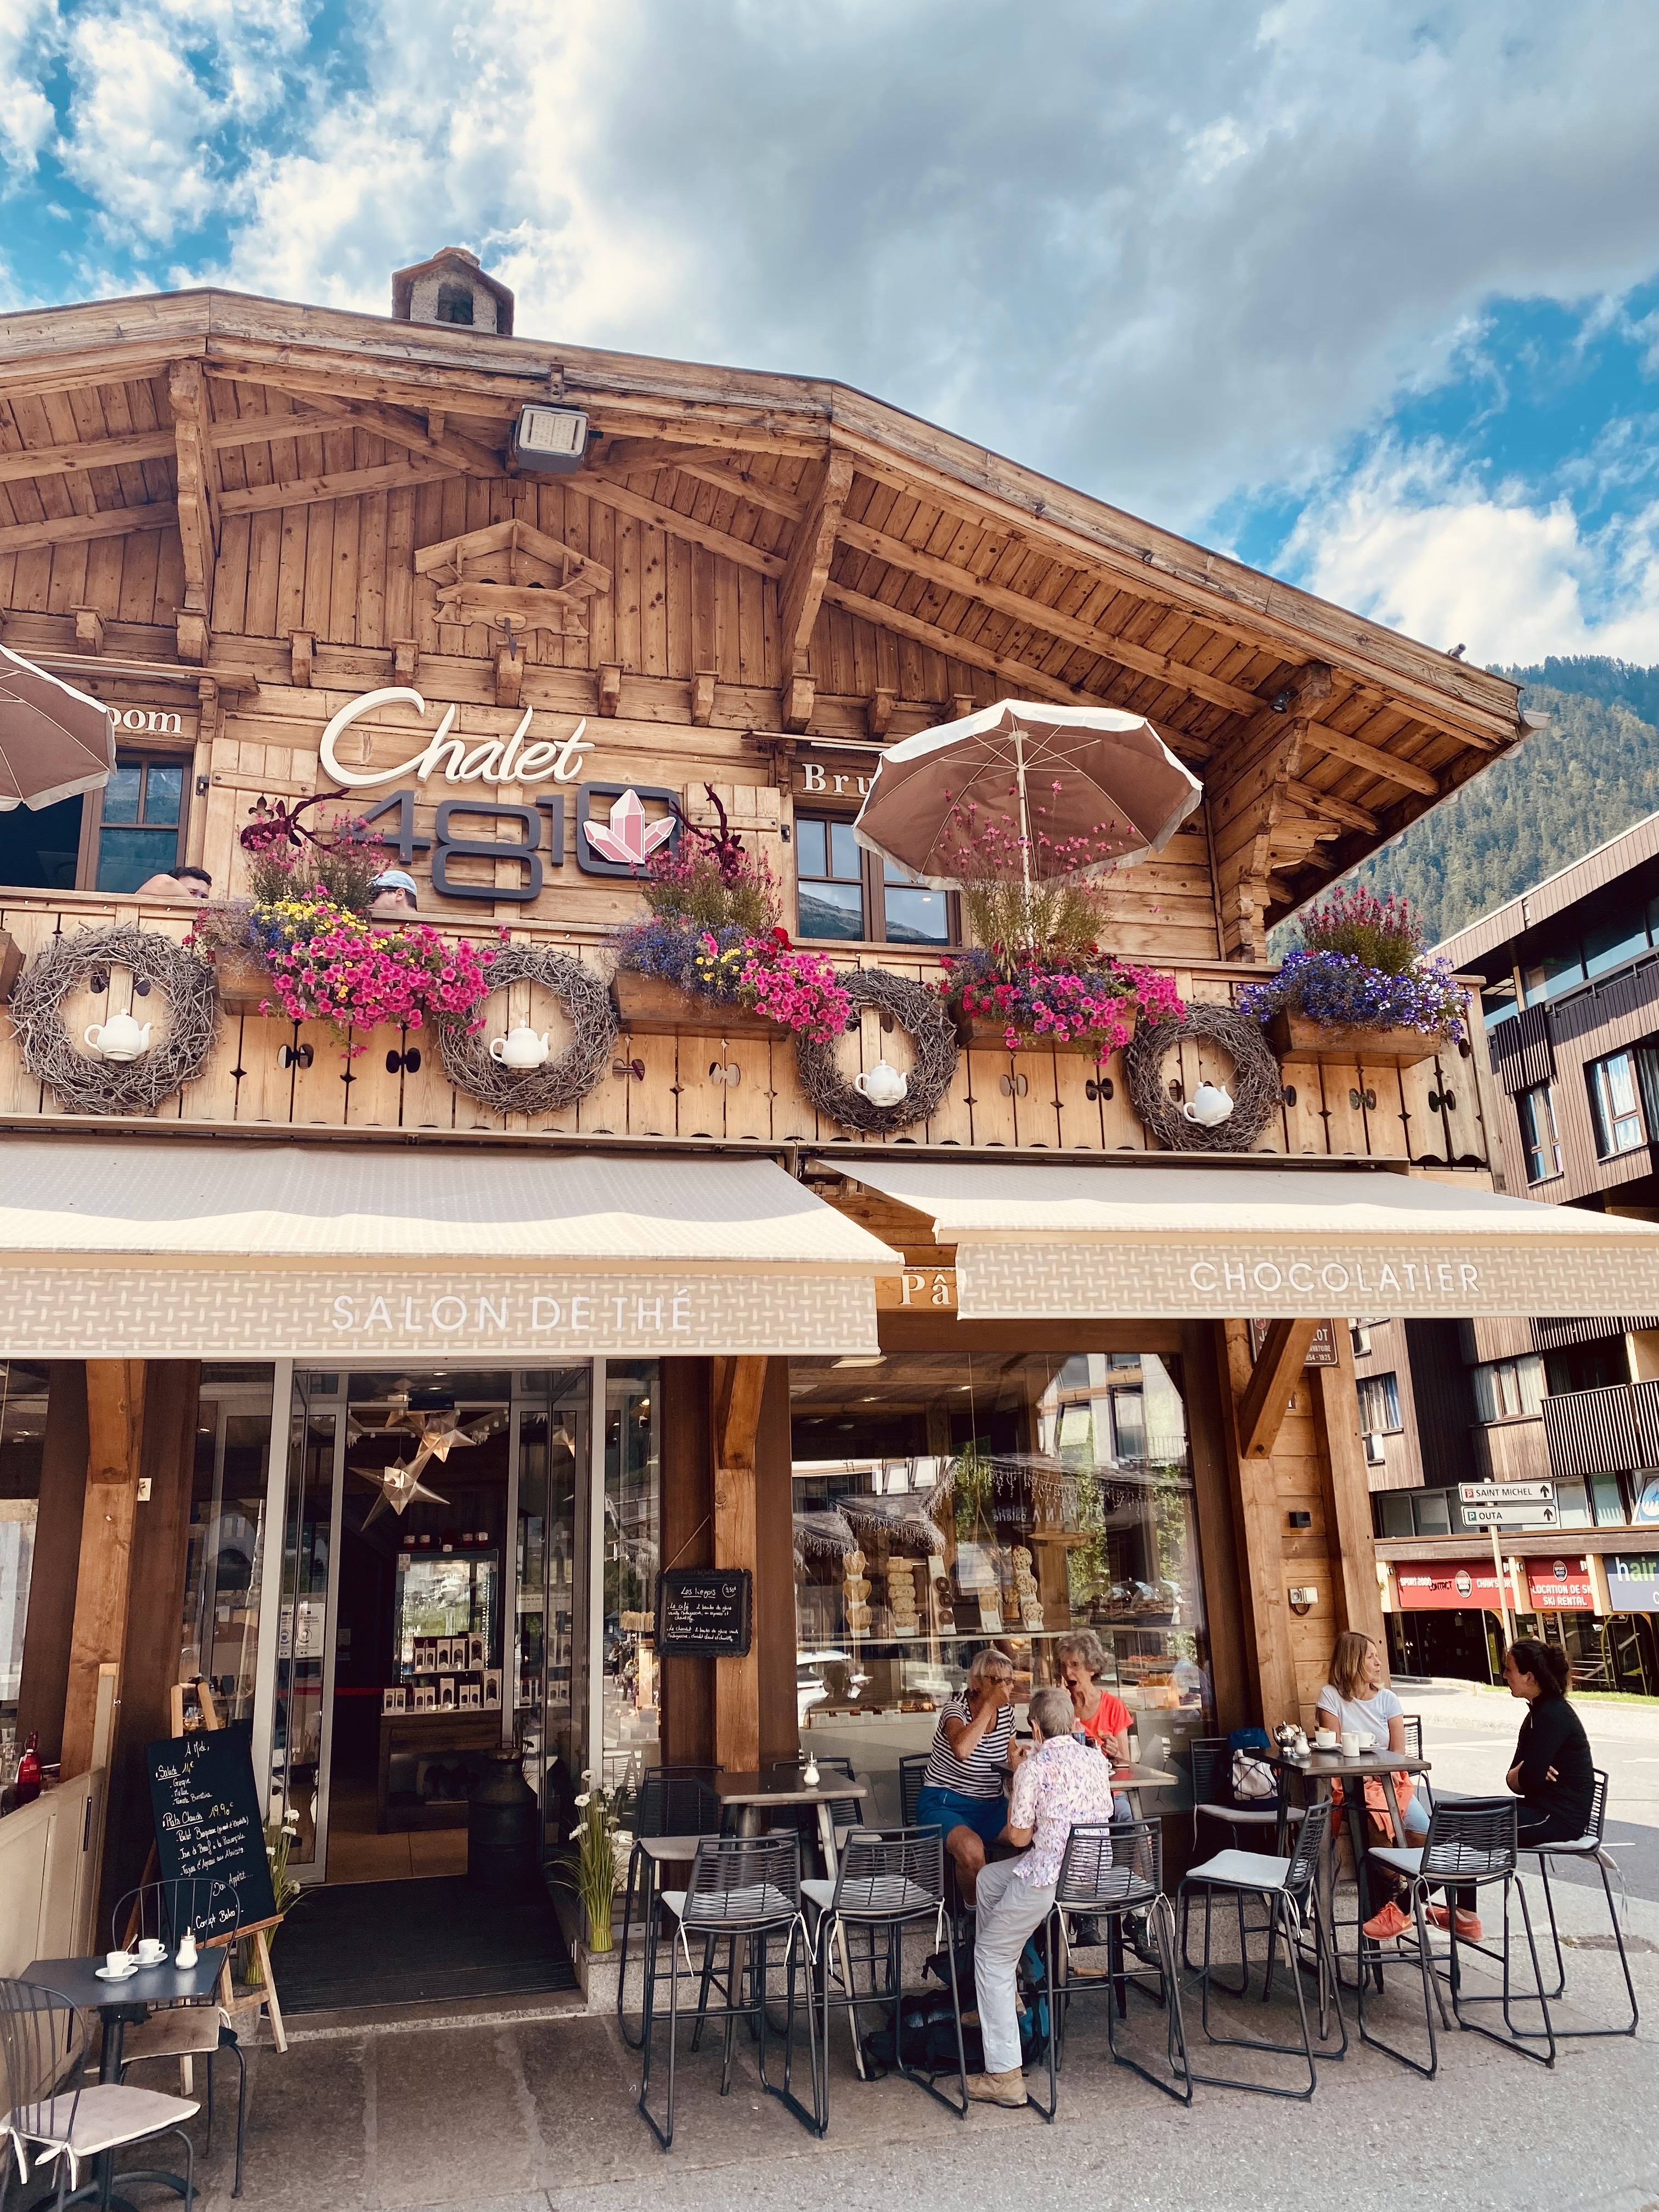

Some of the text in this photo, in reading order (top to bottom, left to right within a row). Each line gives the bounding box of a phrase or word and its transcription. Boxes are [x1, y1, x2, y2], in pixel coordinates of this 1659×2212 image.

[319, 686, 595, 784] Chalet
[340, 781, 685, 901] 4810
[1190, 1262, 1480, 1292] CHOCOLATIER
[331, 1288, 691, 1330] SALON DE THÉ
[1502, 1488, 1532, 1496] MICHEL
[1615, 1556, 1657, 1582] hair
[681, 1586, 692, 1595] Les
[1532, 1584, 1591, 1594] LOCATION DE SK
[1543, 1596, 1588, 1606] SKI RENTAL
